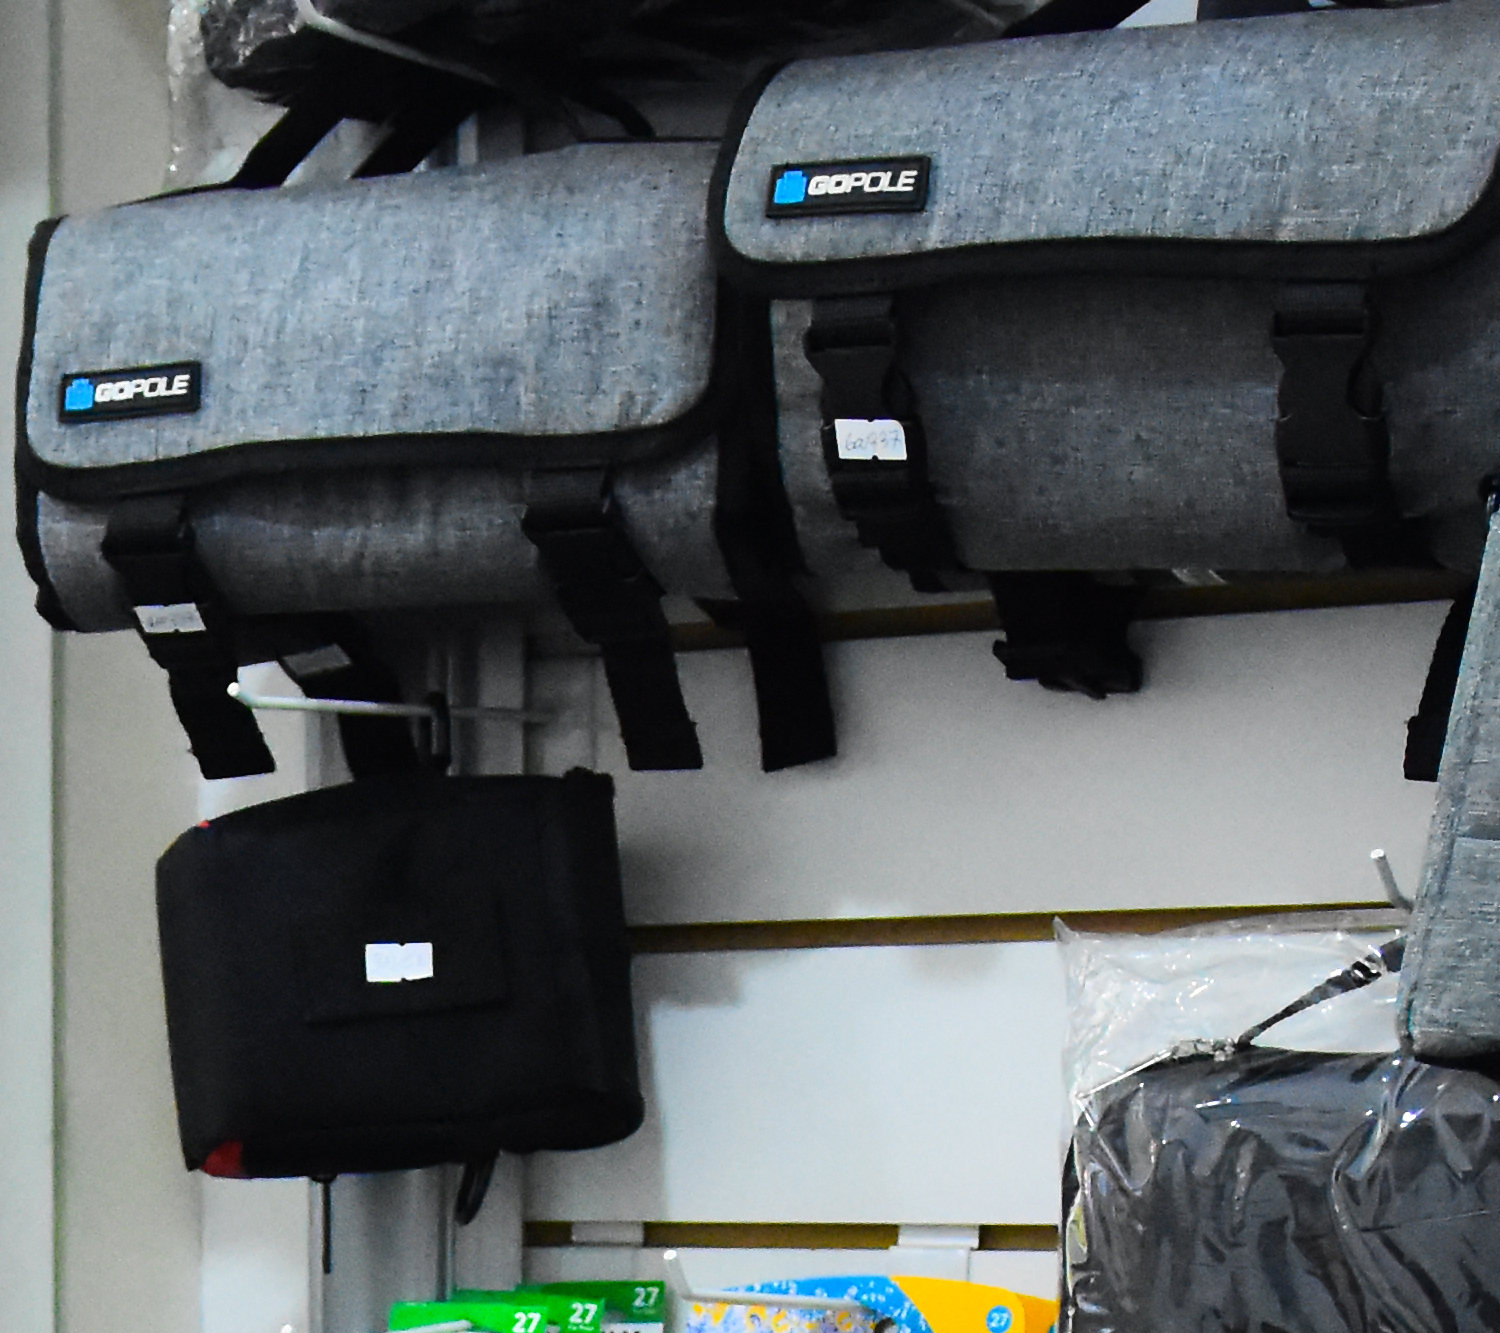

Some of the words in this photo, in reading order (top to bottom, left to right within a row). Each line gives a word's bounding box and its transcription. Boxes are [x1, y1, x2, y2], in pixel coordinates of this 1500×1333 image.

[808, 170, 918, 195] GOPOLE
[95, 374, 190, 402] GOPOLE
[633, 1287, 659, 1307] 27
[512, 1312, 541, 1333] 27
[569, 1302, 598, 1324] 27
[990, 1313, 1008, 1328] 27
